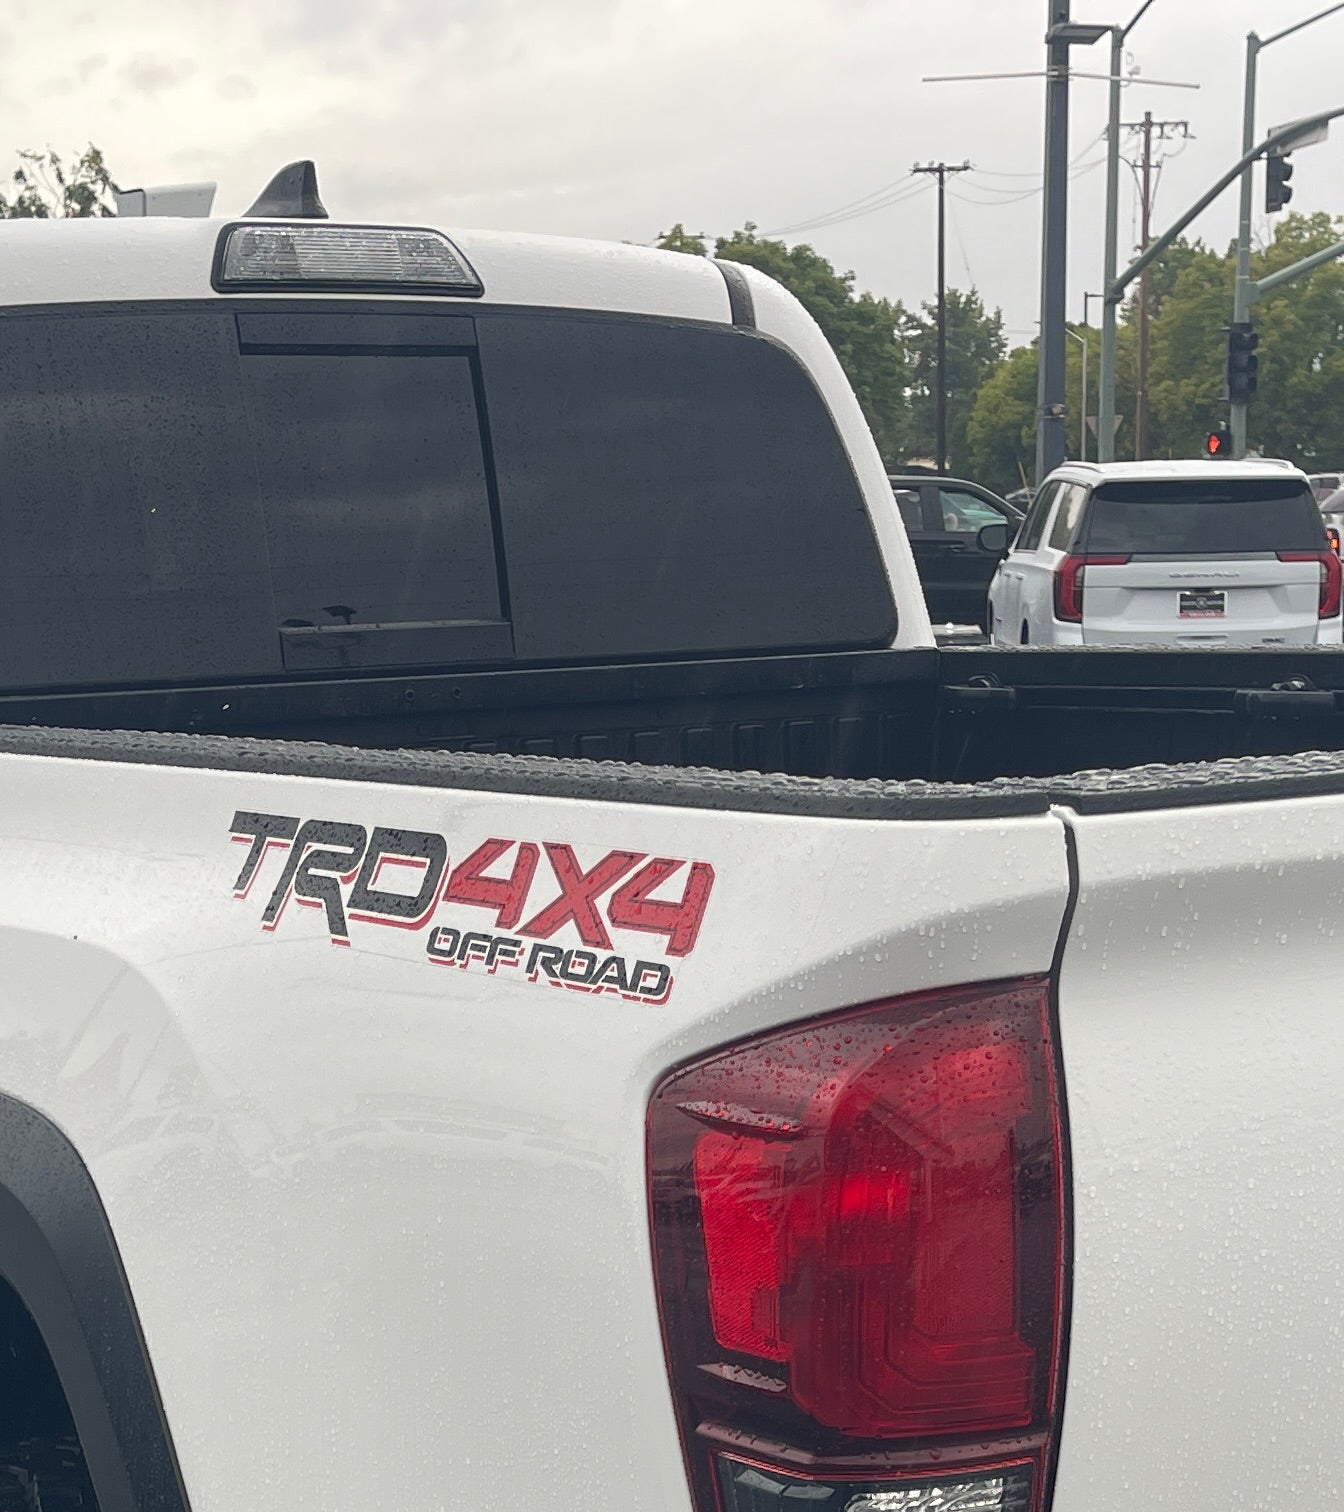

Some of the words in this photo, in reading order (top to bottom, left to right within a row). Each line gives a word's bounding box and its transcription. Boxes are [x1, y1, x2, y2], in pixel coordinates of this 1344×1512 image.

[229, 810, 449, 947] TRD
[442, 837, 716, 958] 4X4
[427, 926, 524, 973] OFF
[524, 943, 674, 1006] ROAD
